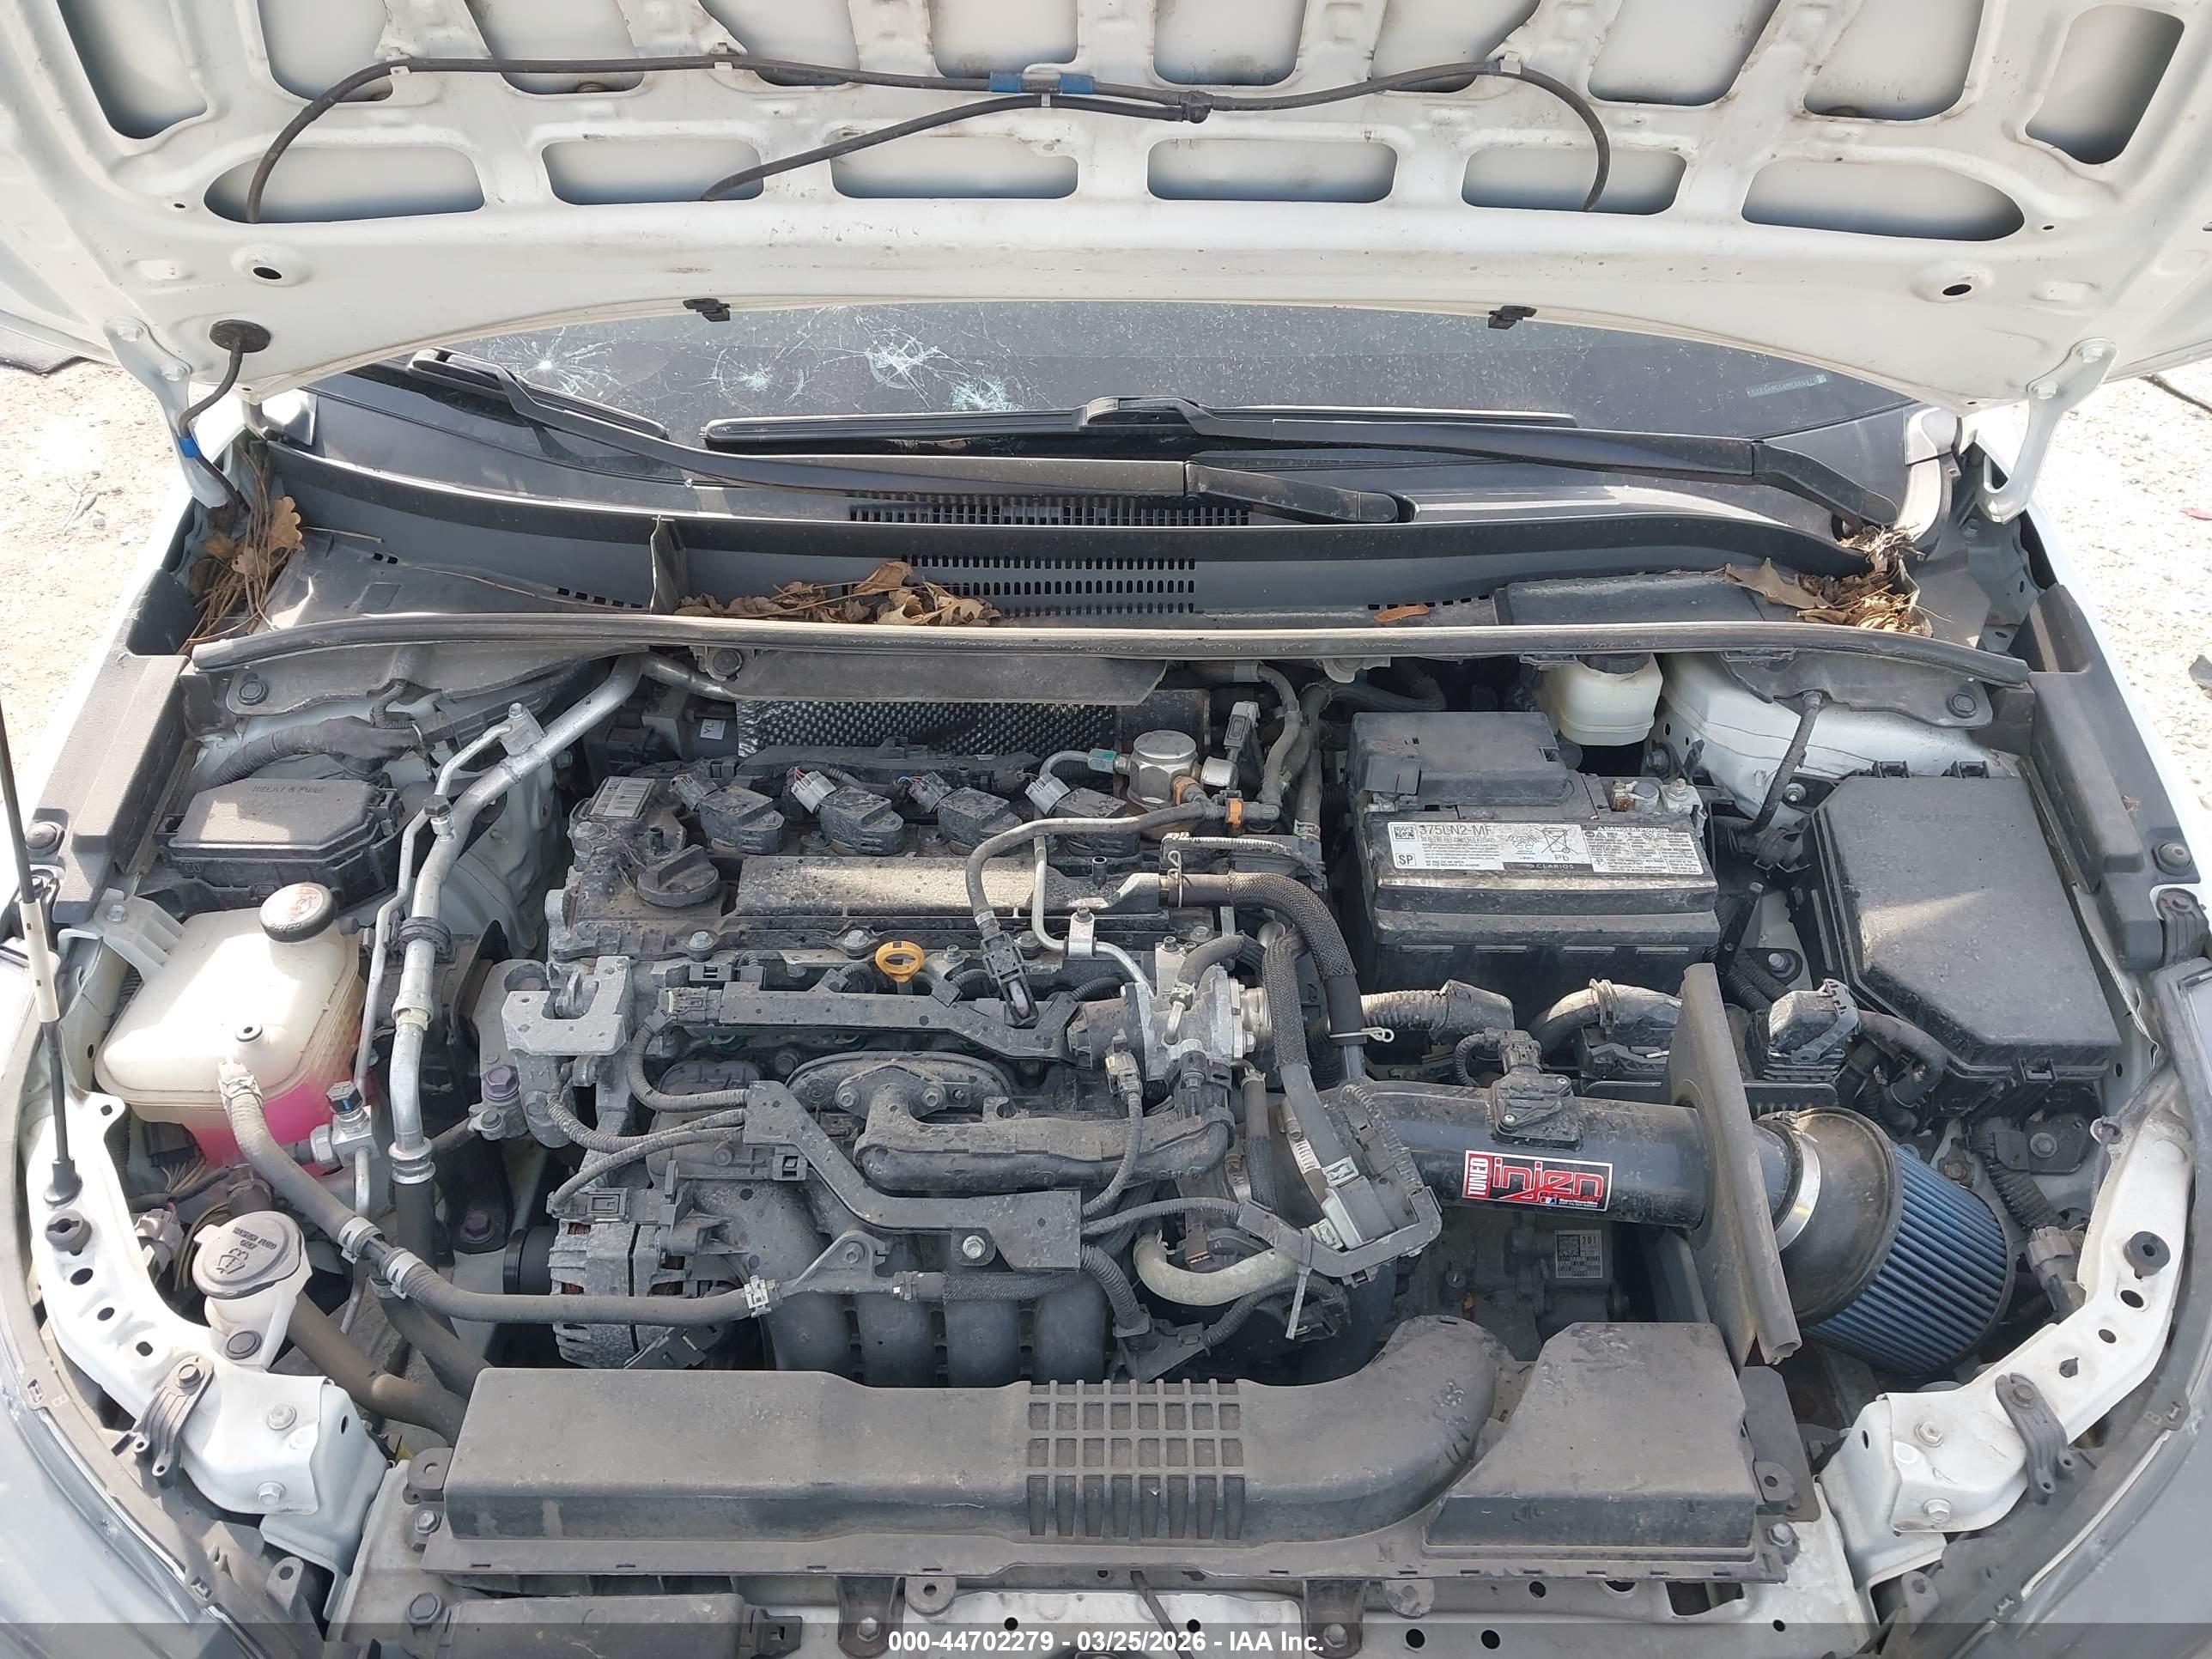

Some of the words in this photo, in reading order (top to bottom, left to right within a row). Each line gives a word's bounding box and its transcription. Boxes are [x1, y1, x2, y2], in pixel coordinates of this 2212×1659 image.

[1419, 824, 1492, 836] 375LN2-MF
[1398, 854, 1413, 865] SP
[1468, 1157, 1489, 1196] TUNED
